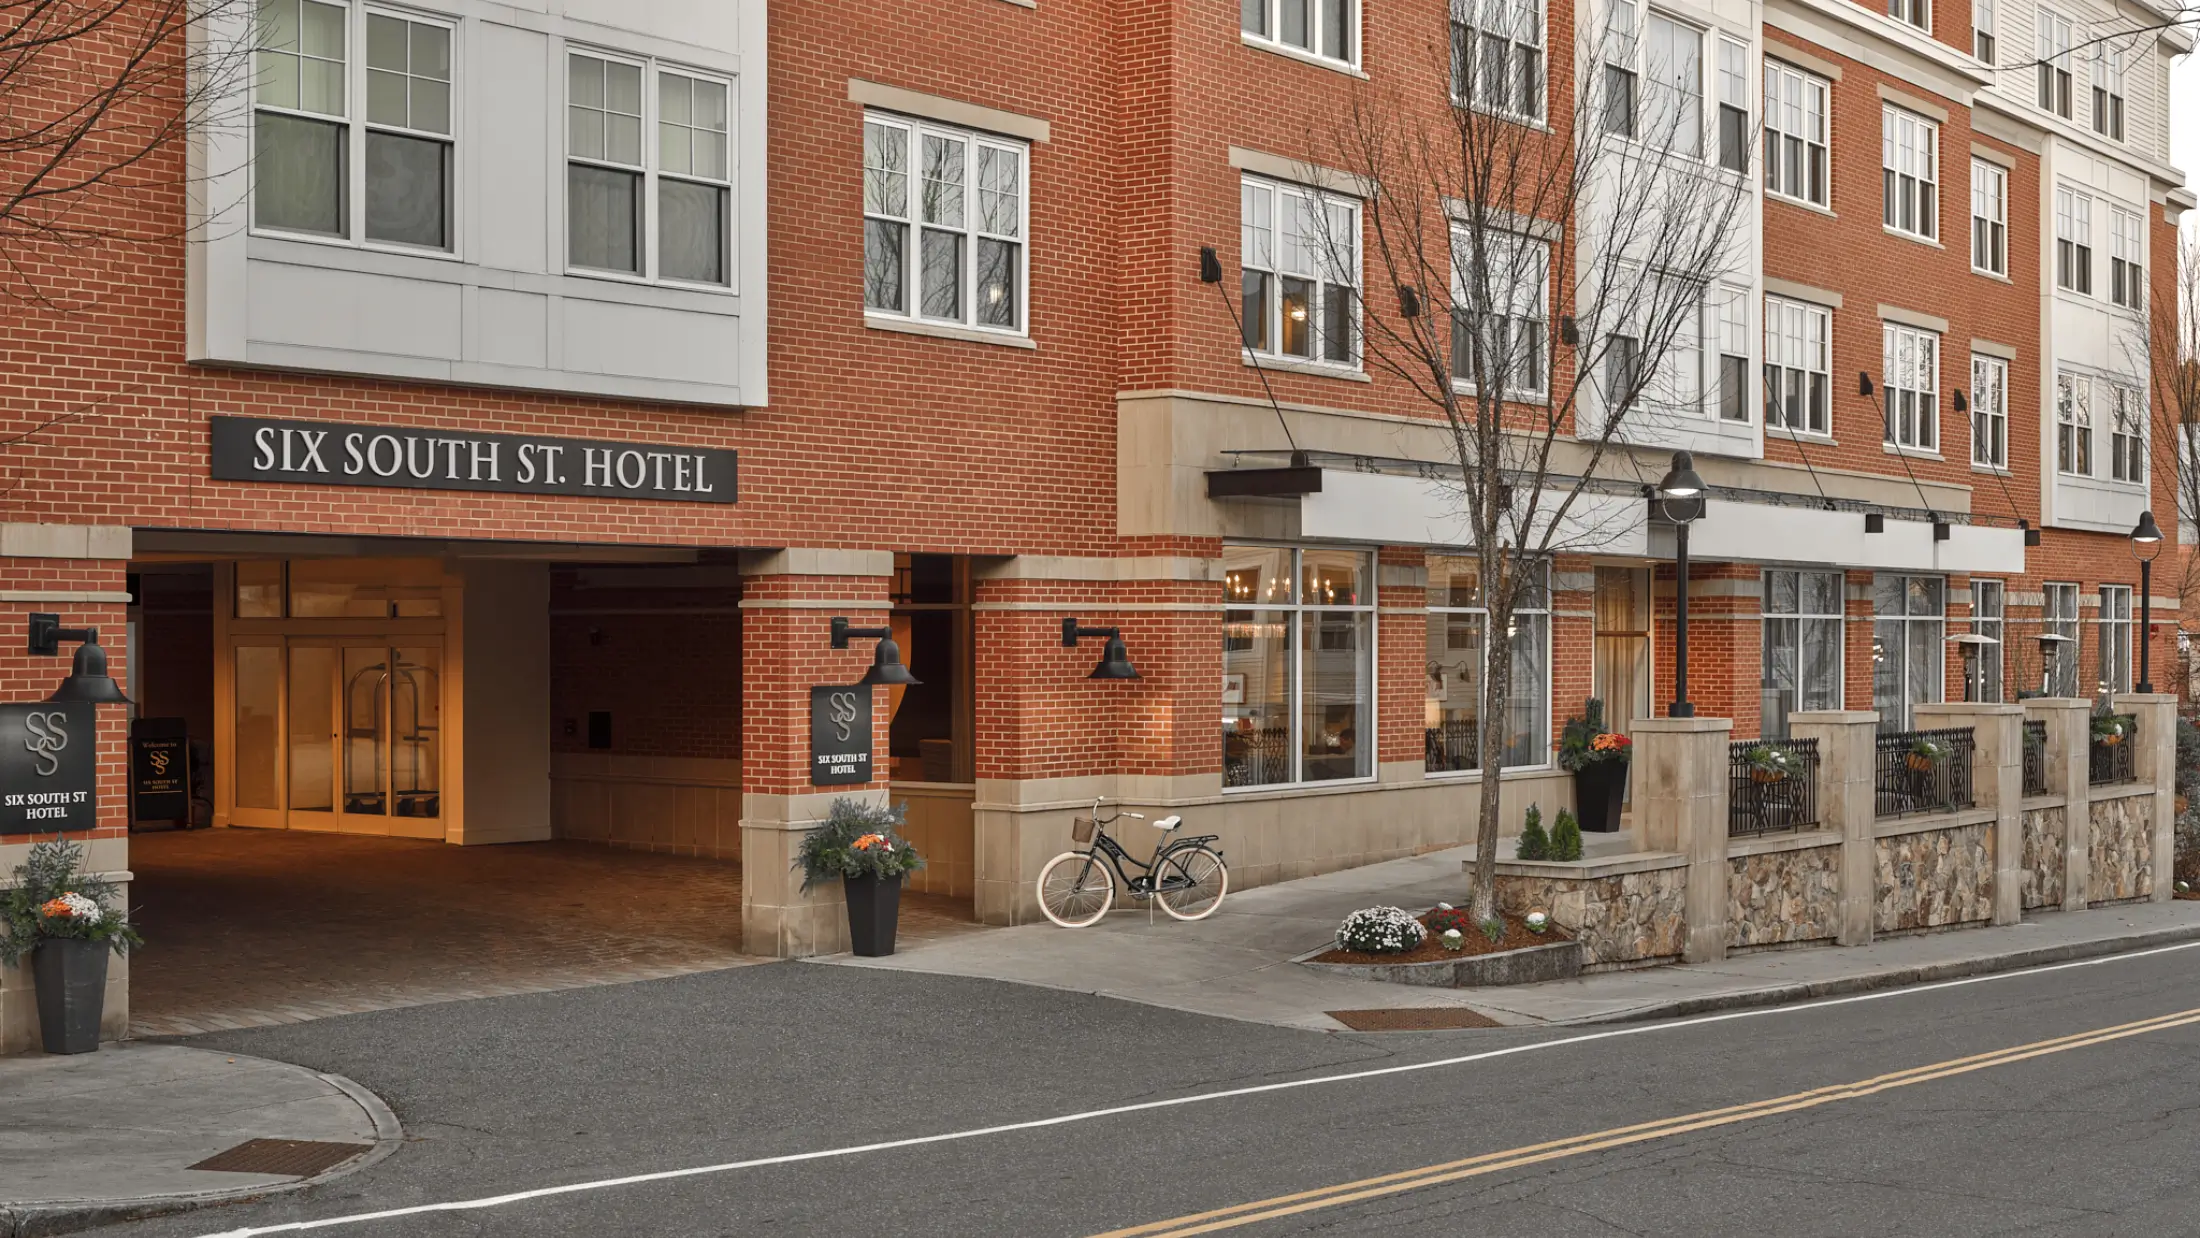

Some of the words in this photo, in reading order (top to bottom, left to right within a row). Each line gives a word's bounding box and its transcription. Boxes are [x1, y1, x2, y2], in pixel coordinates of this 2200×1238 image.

[253, 427, 330, 474] SIX
[343, 432, 502, 482] SOUTH
[516, 443, 567, 484] ST.
[582, 447, 713, 493] HOTEL
[818, 755, 831, 764] SIX
[831, 754, 857, 763] SOUTH
[858, 753, 867, 762] ST
[830, 765, 856, 774] HOTEL
[5, 795, 24, 806] SIX
[27, 793, 70, 805] SOUTH
[73, 791, 87, 802] ST
[26, 807, 68, 820] HOTEL
